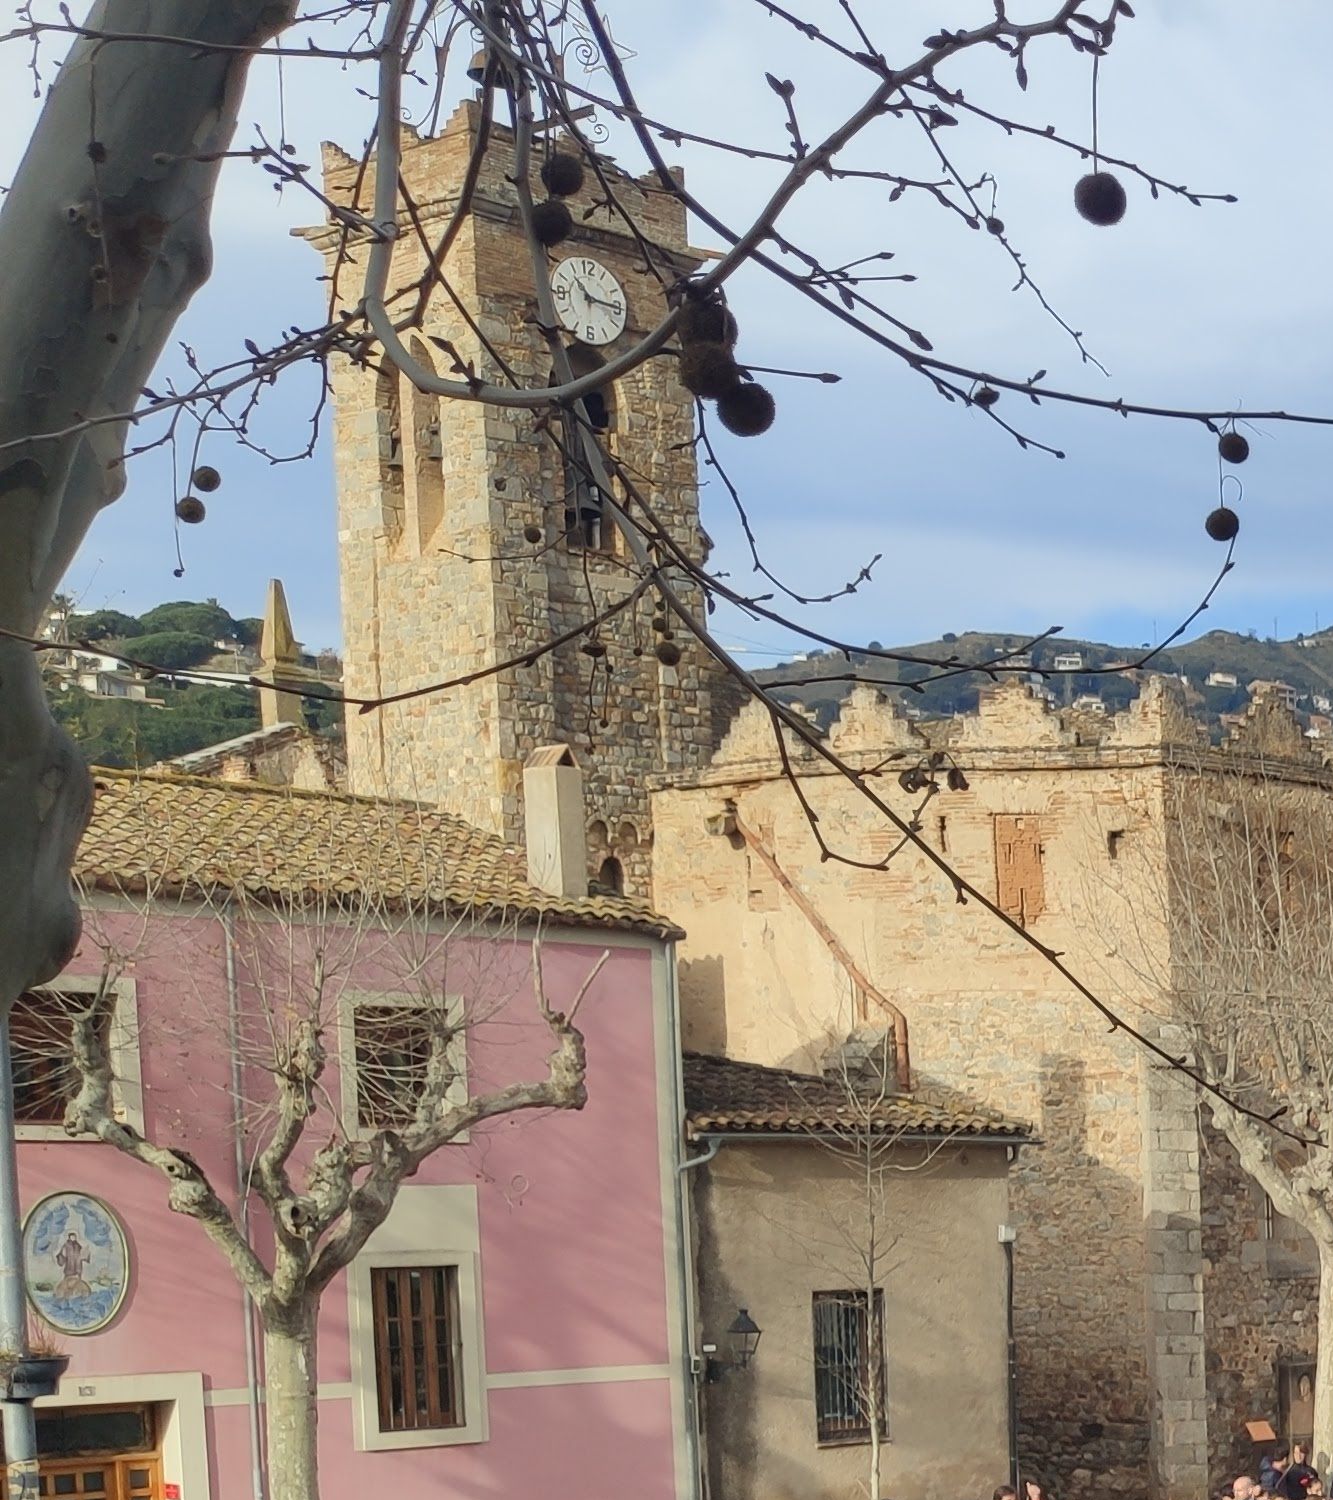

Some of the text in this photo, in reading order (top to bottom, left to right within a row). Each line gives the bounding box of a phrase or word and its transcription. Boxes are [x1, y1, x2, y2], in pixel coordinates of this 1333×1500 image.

[581, 259, 596, 276] 12
[612, 300, 622, 315] 3
[586, 325, 595, 341] 6
